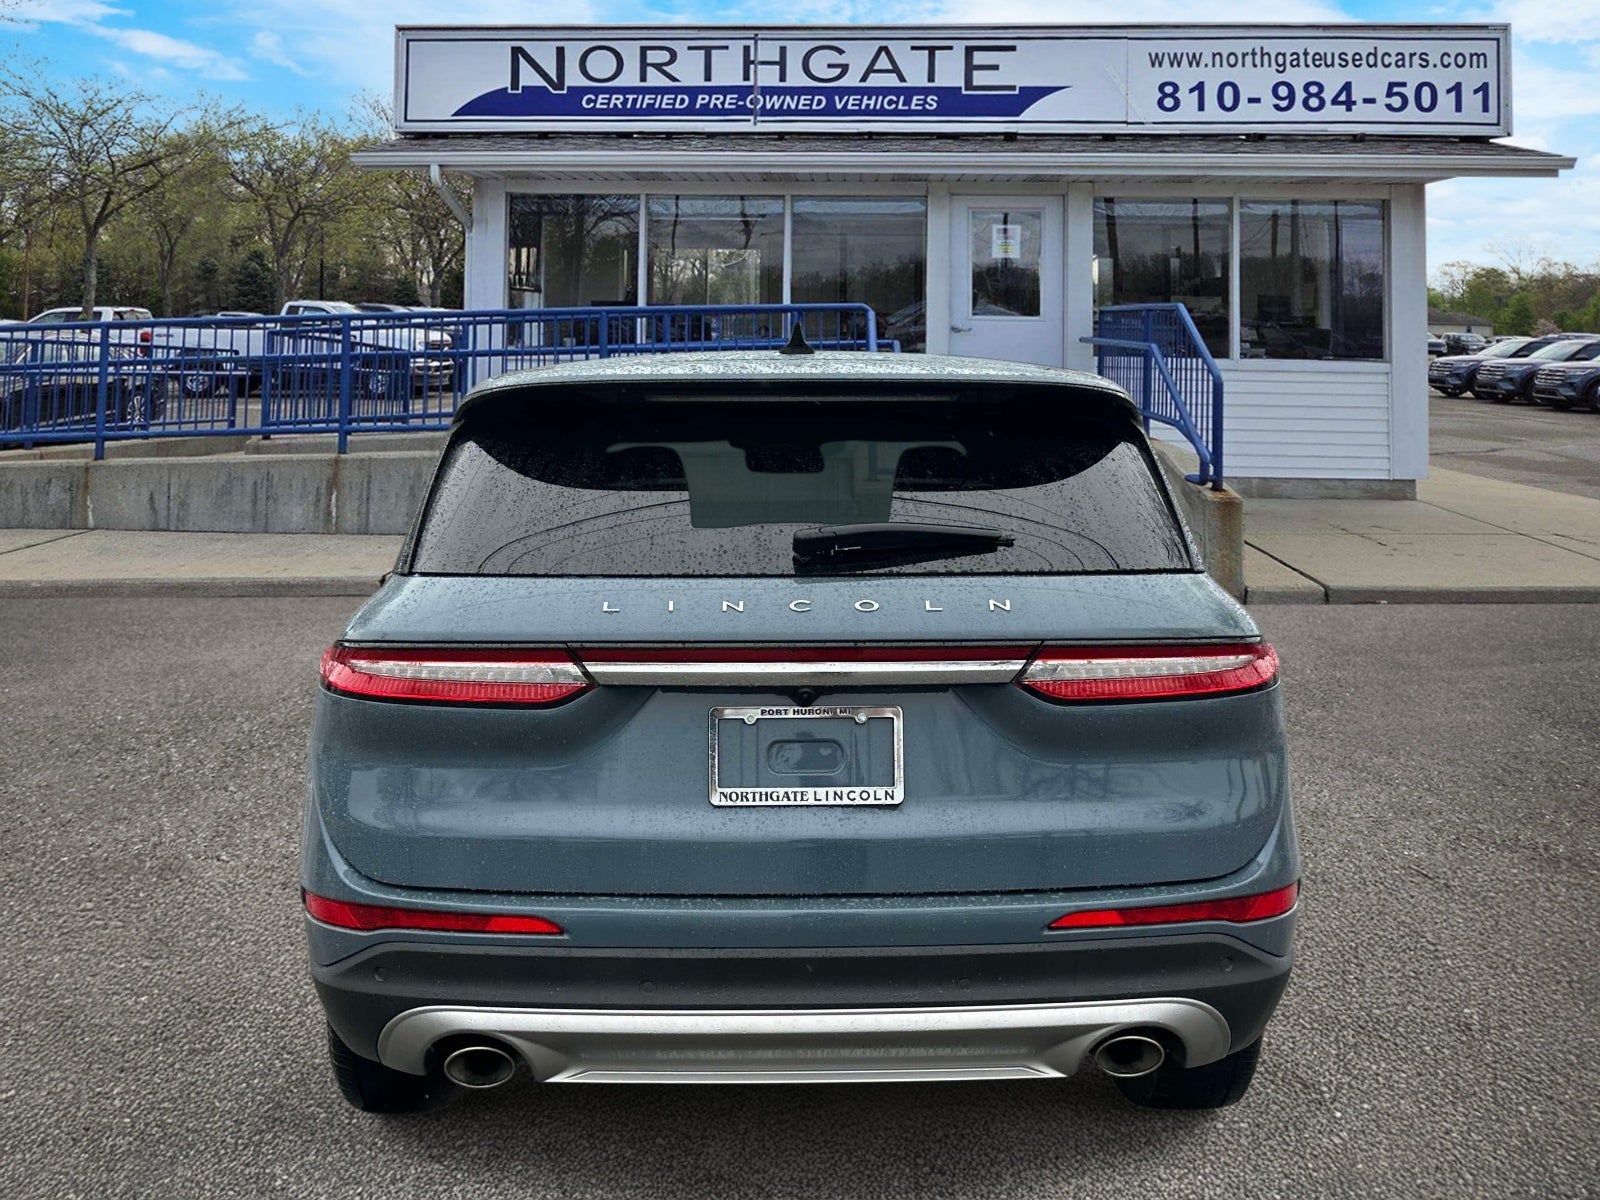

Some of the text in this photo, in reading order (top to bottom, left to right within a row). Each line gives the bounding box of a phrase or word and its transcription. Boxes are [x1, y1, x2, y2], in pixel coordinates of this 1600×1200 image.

[1148, 47, 1488, 73] www.northgateusedcars.com
[510, 45, 1017, 92] NORTHGATE
[581, 94, 939, 110] CERTIFIED PRE-OWNED VEHICLES
[1156, 81, 1491, 113] 810-984-5011
[602, 599, 1012, 612] LINCOLN
[760, 708, 789, 716] PORT
[719, 790, 895, 802] NORTHGATE LINCOLN
